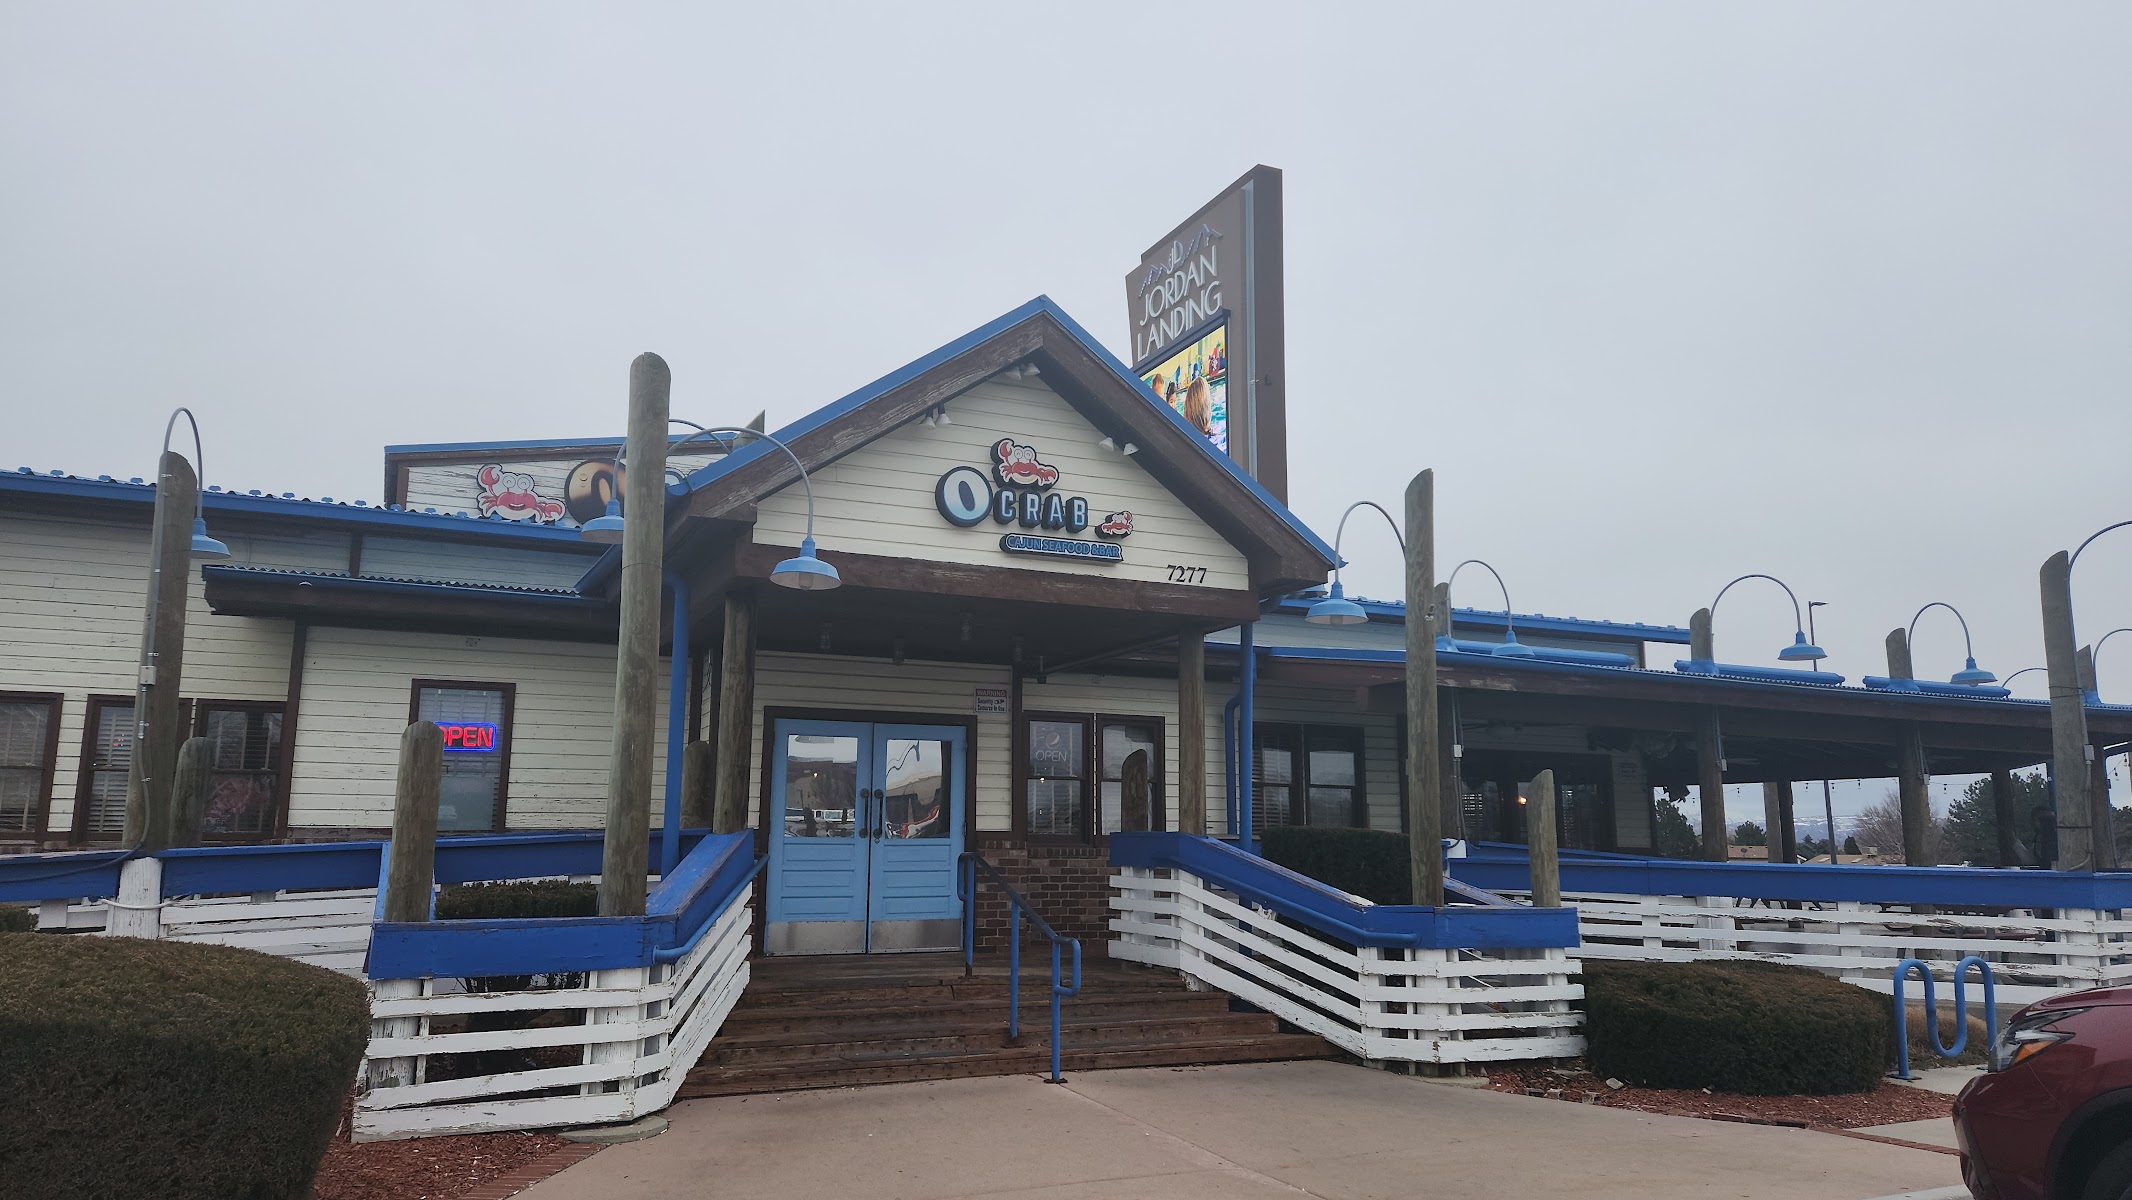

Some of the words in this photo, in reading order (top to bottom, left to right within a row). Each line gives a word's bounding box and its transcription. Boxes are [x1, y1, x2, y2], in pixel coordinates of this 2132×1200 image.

[1139, 244, 1217, 327] JORDAN
[1137, 281, 1222, 362] LANDING
[938, 467, 992, 525] O
[996, 488, 1088, 531] CRAB
[1007, 535, 1041, 550] CAJUN
[1042, 538, 1091, 555] SEAFOOD
[1166, 564, 1207, 584] 7277
[1036, 750, 1067, 761] OPEN
